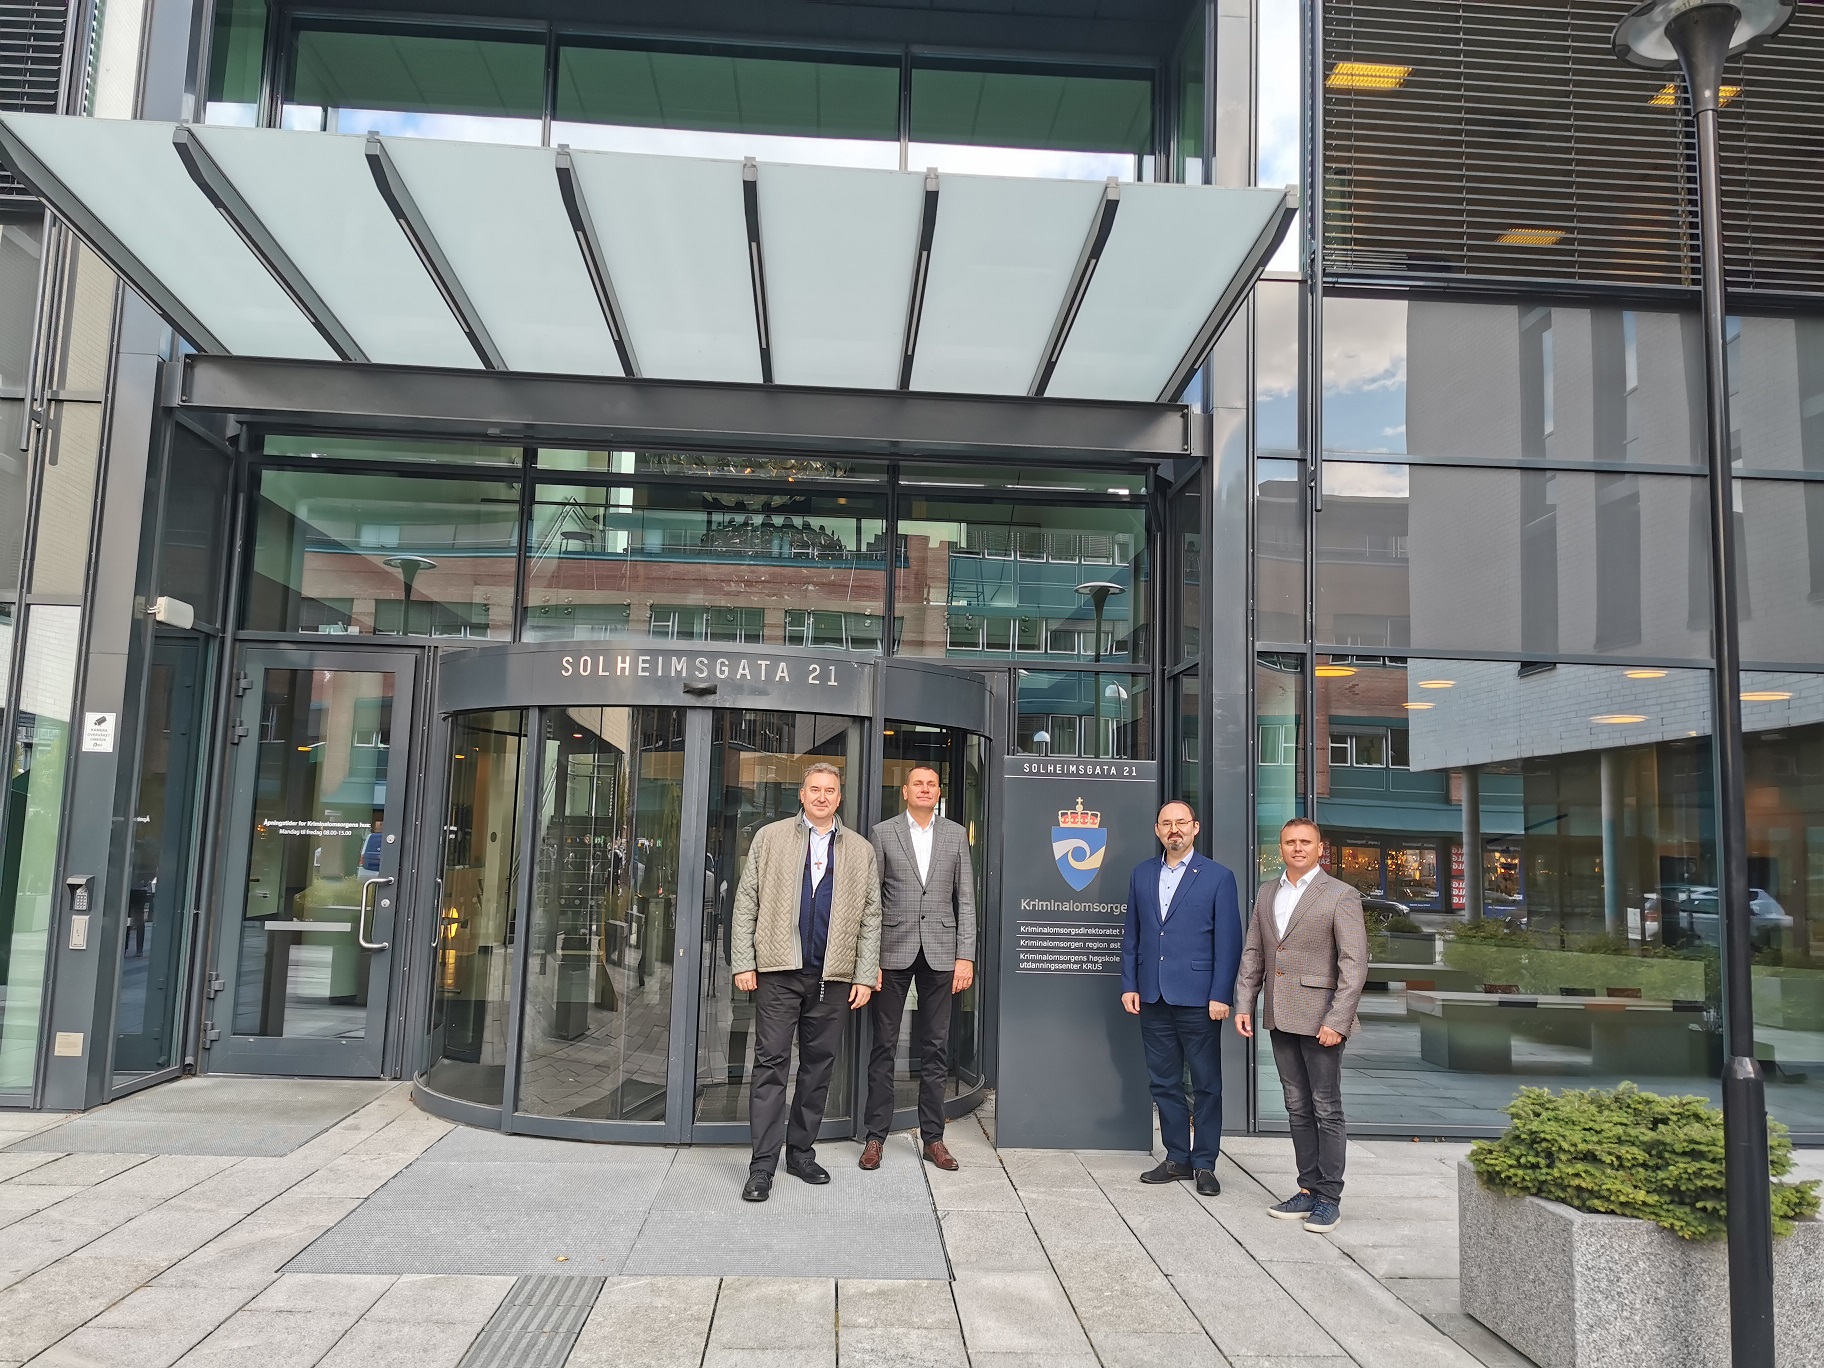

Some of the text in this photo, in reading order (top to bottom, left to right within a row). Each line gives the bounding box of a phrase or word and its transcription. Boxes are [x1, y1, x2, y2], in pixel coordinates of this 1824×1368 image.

[561, 655, 838, 686] SOLHEIMSGATA 21
[1023, 763, 1137, 776] SOLHEIMSGATA 21
[279, 828, 300, 836] Mandag
[1021, 898, 1127, 915] Kriminalomsorge
[1020, 925, 1120, 935] Kriminalomsorgsdirektoratet
[1020, 939, 1083, 950] Kriminalomsorgen
[1085, 942, 1108, 950] region
[1019, 952, 1121, 963] Kriminalomsorgens høgskole
[1019, 961, 1103, 971] utdanningssenter KRUS
